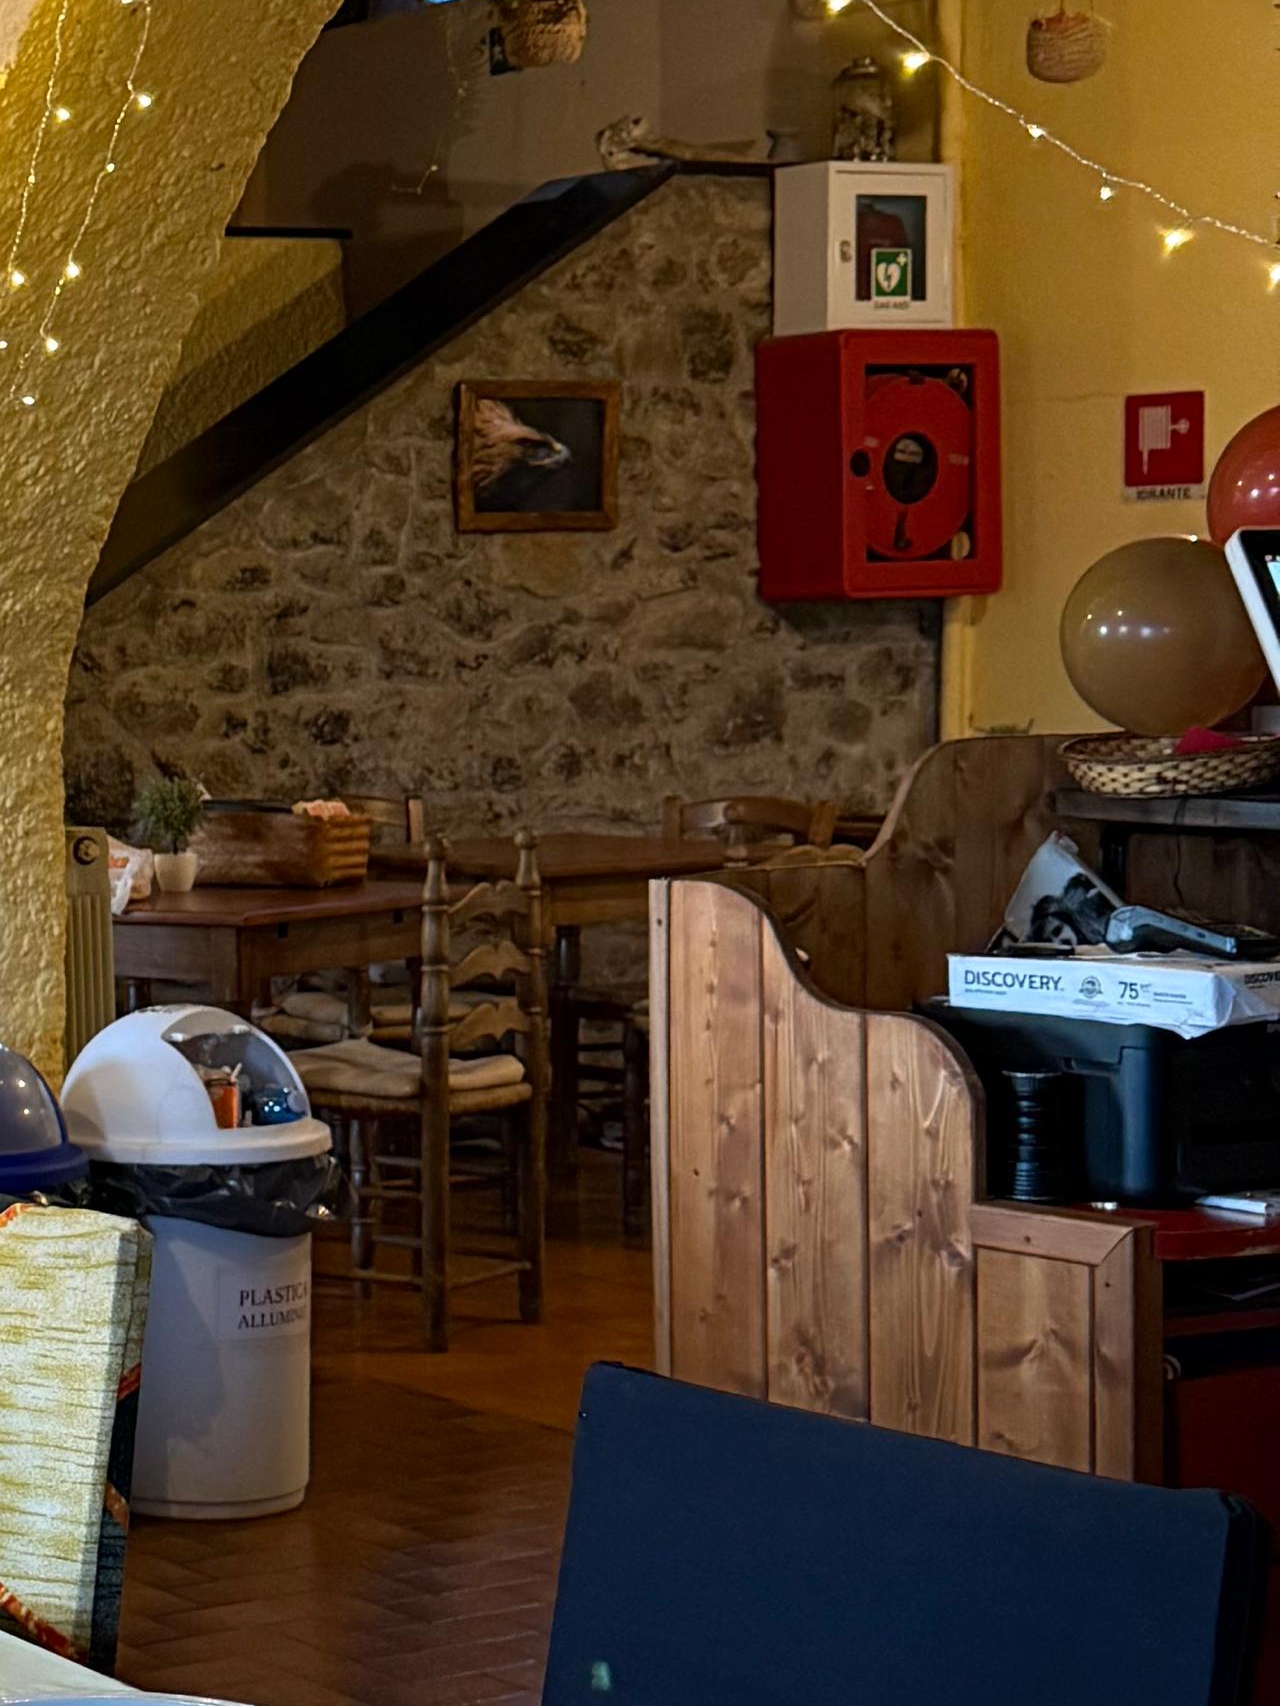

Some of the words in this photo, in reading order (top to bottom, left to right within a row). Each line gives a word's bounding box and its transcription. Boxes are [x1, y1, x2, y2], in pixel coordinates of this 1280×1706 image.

[1136, 486, 1191, 500] IDRANTE
[964, 970, 1062, 991] DISCOVERY
[1118, 981, 1139, 1000] 75
